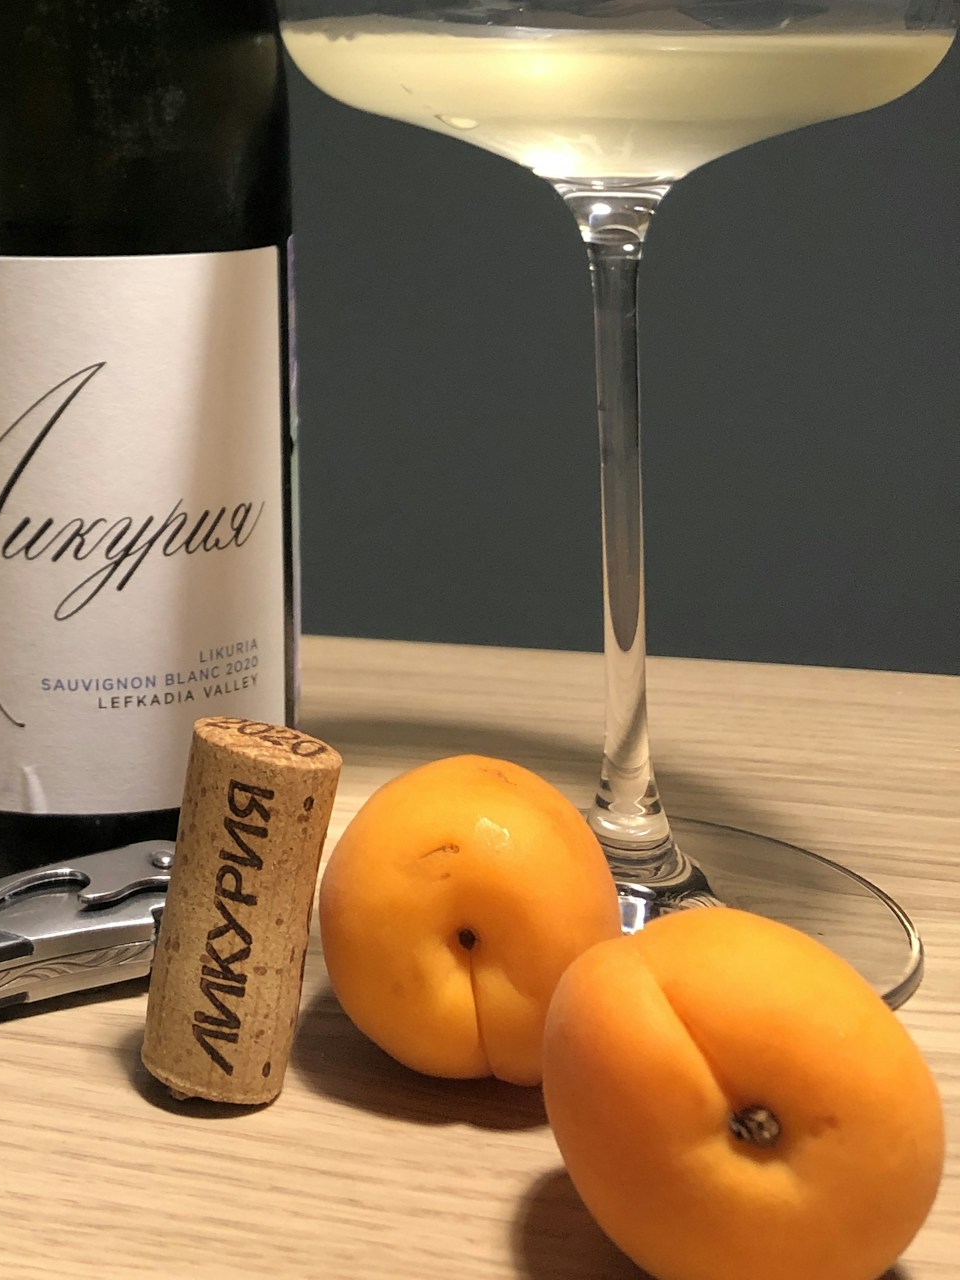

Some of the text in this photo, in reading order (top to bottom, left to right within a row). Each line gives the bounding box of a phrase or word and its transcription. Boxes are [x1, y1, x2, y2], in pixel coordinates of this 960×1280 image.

[199, 638, 258, 663] LIKURIA
[41, 655, 258, 691] SAUVIGNON BLANC 2020
[98, 673, 258, 709] LEFKADIA VALLEY
[205, 718, 326, 757] 2020
[192, 779, 275, 1076] ЛИКУРИЯ
